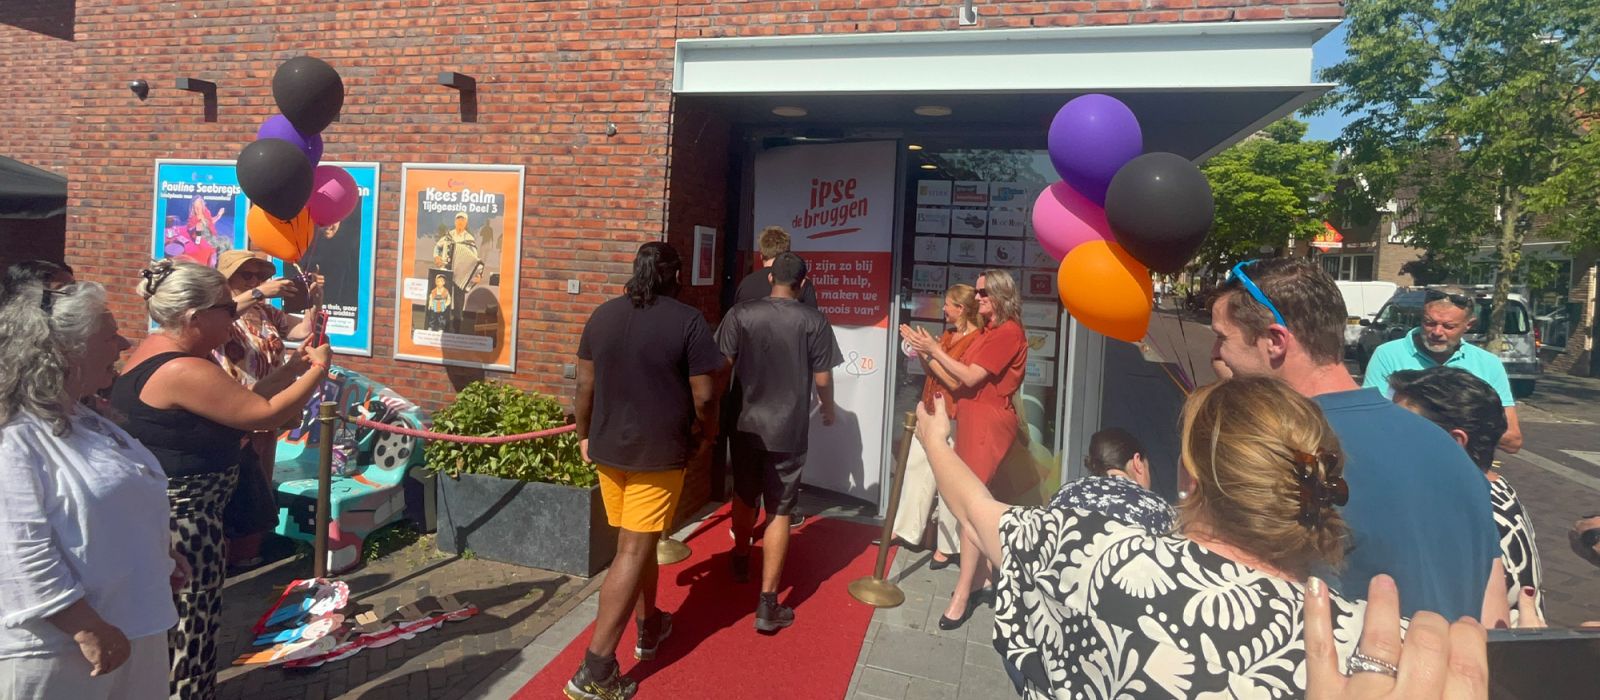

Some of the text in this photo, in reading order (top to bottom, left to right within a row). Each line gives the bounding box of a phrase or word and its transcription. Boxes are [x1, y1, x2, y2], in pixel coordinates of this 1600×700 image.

[162, 181, 195, 193] Pauline
[196, 182, 241, 196] Seebregts
[425, 187, 496, 204] Kees Balm
[810, 178, 857, 210] ipse
[422, 200, 498, 214] Tijdgeestig Deel 3
[792, 197, 868, 230] de bruggen
[816, 259, 837, 273] zijn
[839, 262, 852, 271] zo
[855, 260, 873, 274] blij
[812, 274, 871, 289] jullie hulp,
[821, 289, 859, 300] maken
[862, 292, 878, 301] we
